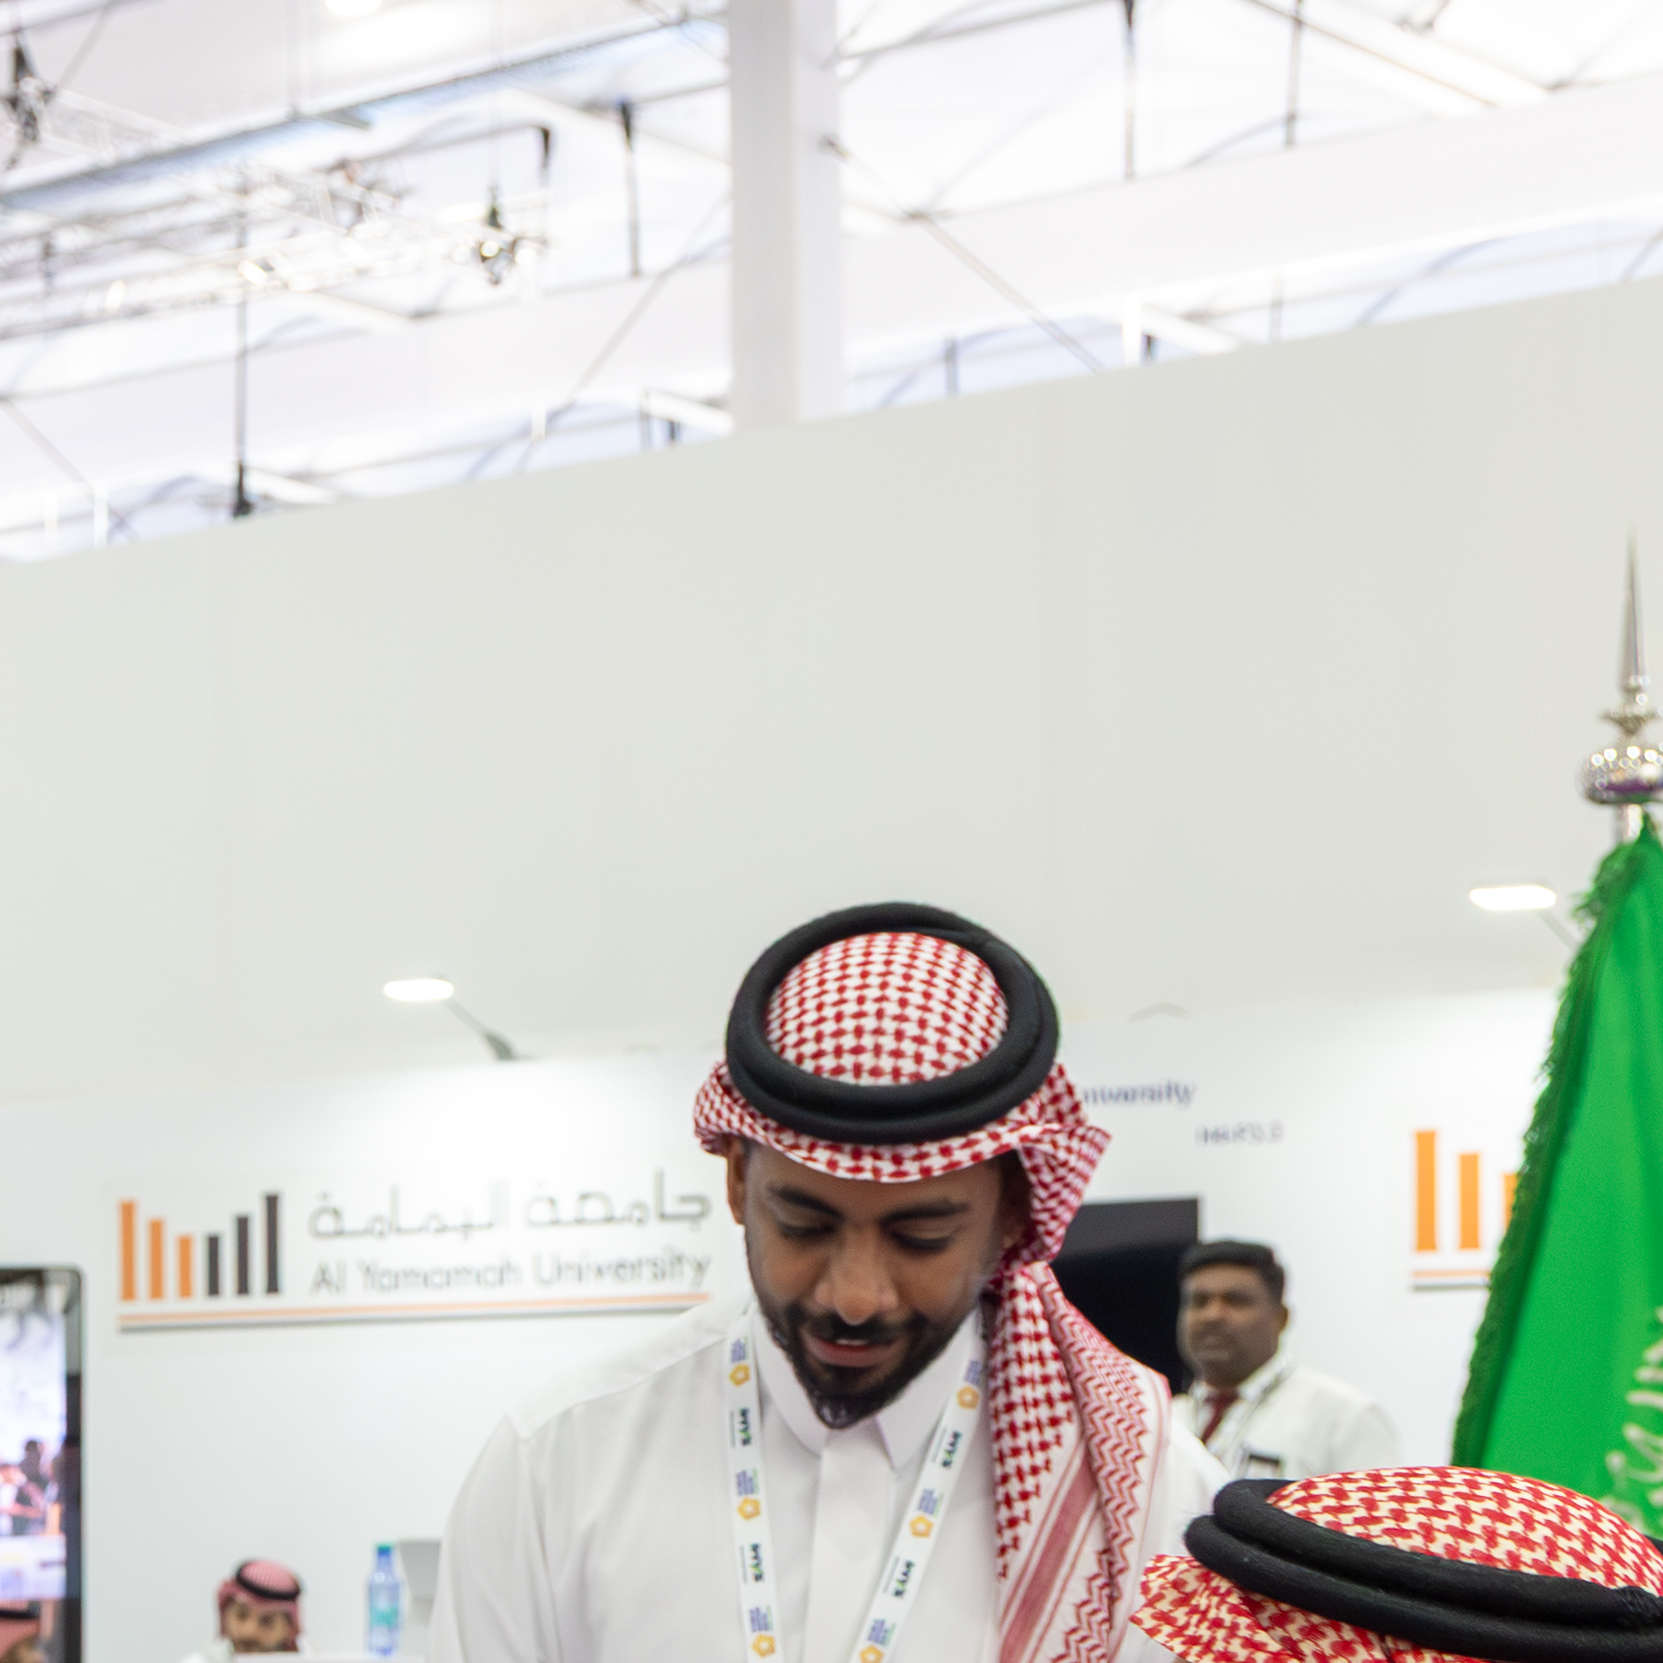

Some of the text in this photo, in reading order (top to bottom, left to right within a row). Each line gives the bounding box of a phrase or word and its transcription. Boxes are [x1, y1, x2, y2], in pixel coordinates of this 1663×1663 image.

[308, 1167, 712, 1240] جامعة اليمامة
[311, 1241, 712, 1295] Al Yamamah University
